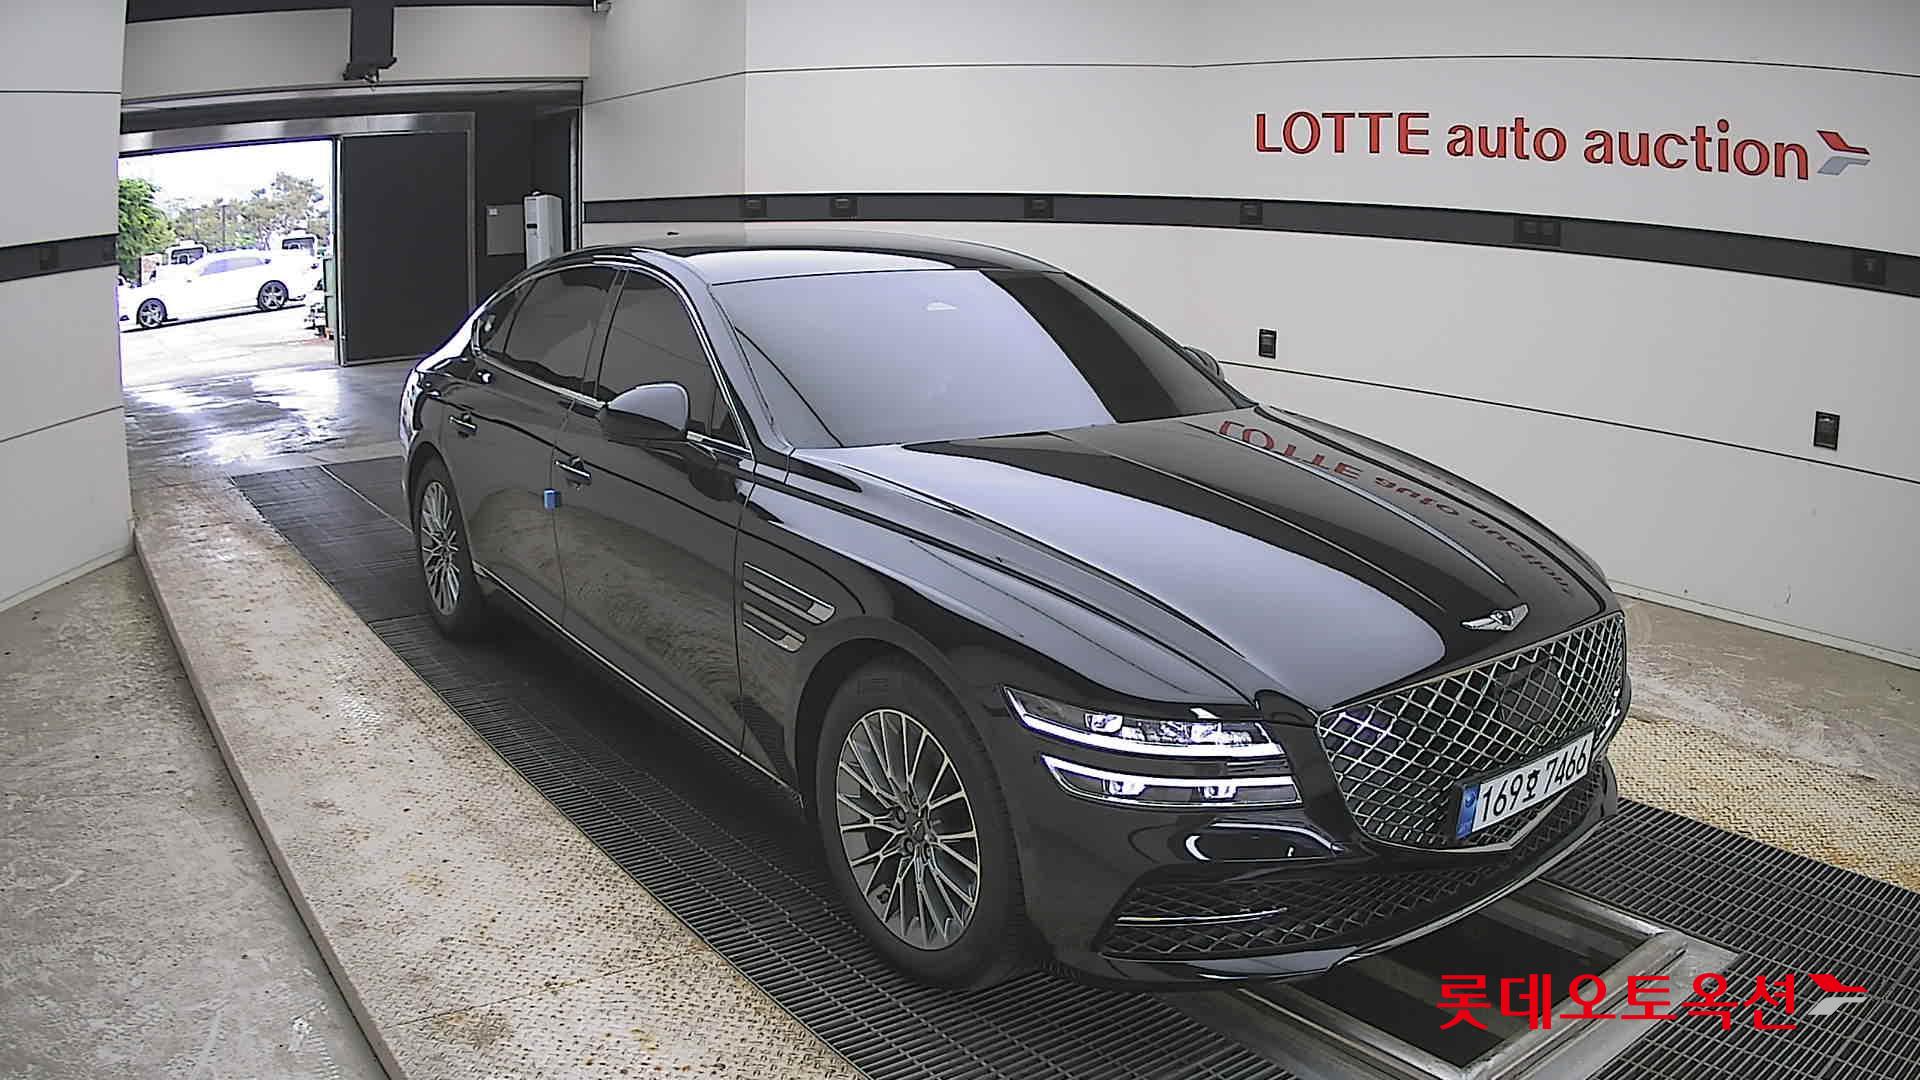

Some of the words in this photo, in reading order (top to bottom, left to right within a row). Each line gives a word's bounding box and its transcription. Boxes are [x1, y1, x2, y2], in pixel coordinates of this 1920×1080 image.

[1254, 111, 1432, 157] LOTTE
[1446, 116, 1569, 162] auto
[1583, 119, 1810, 182] auction
[1543, 739, 1588, 796] 7466
